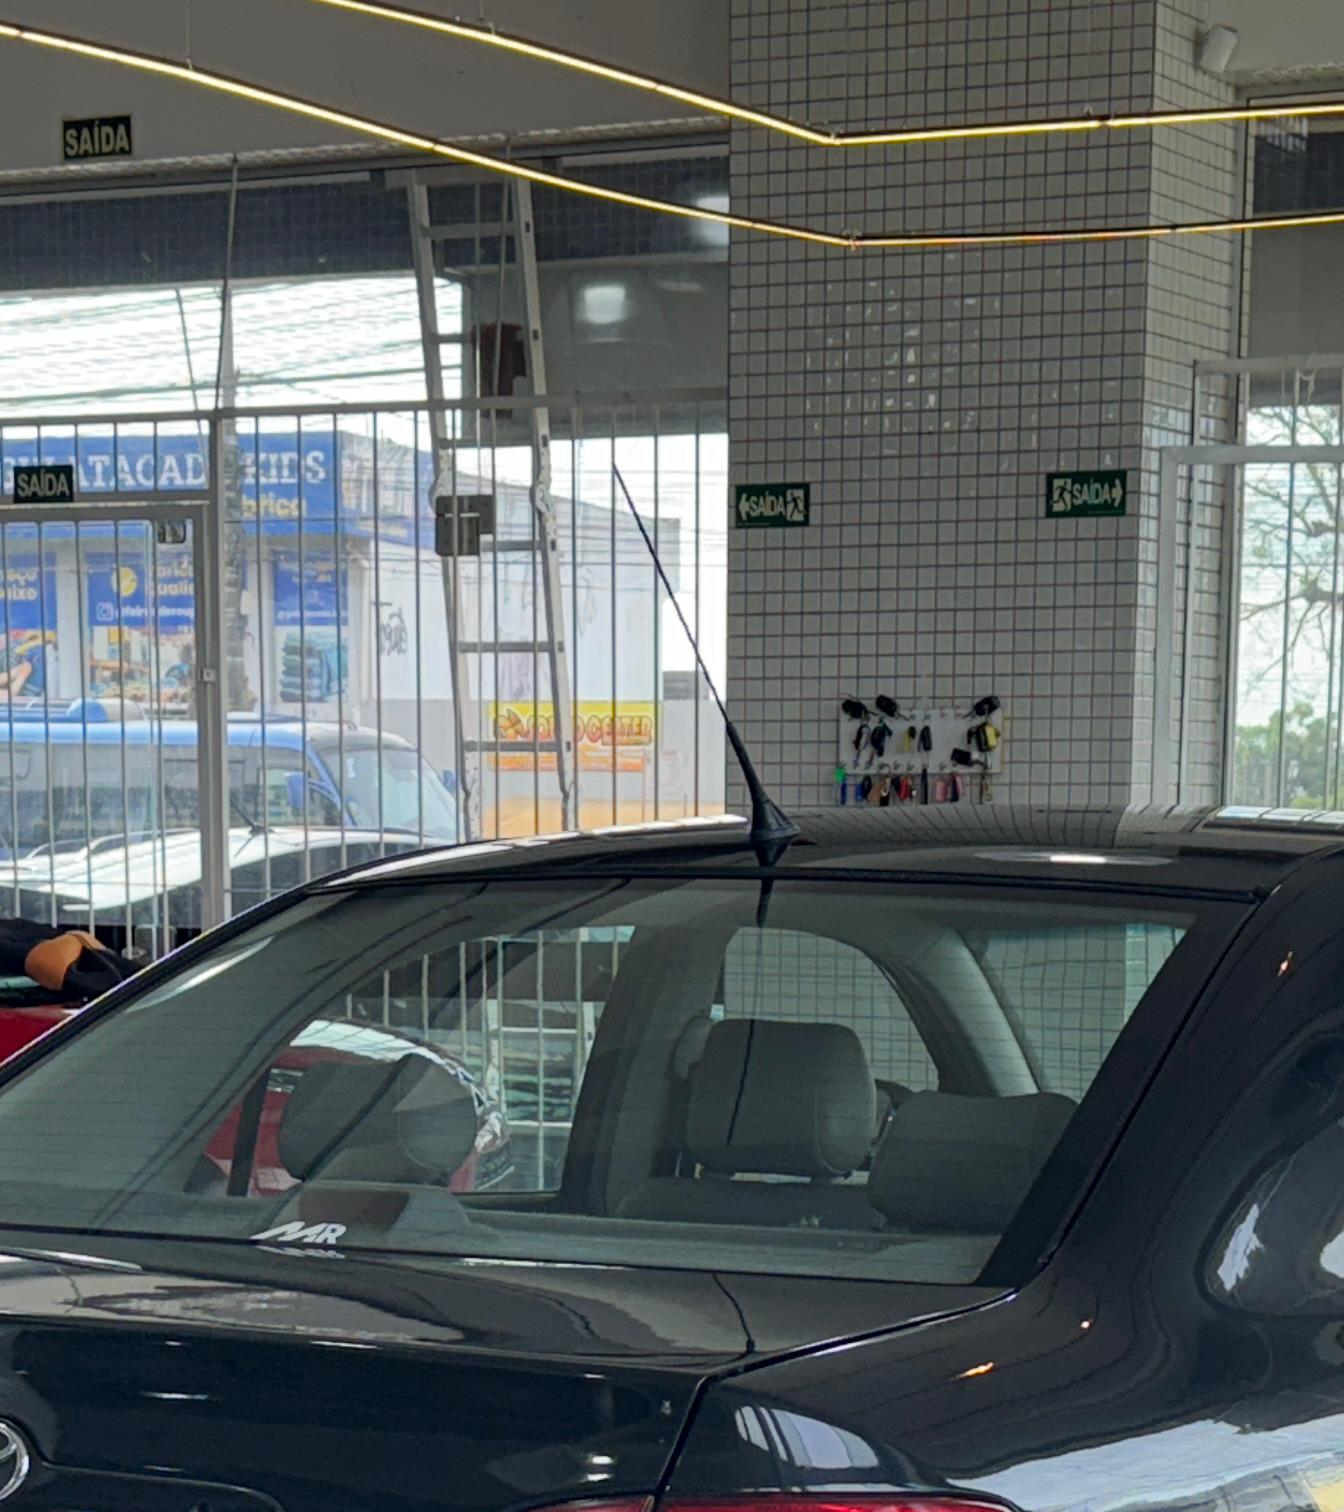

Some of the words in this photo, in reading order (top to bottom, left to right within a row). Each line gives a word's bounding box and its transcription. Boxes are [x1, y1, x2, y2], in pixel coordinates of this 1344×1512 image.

[64, 120, 130, 156] SAÍDA
[17, 467, 70, 498] SAÍDA
[242, 450, 327, 485] KIDS
[749, 489, 786, 517] SAÍDA
[1072, 477, 1112, 506] SAÍDA
